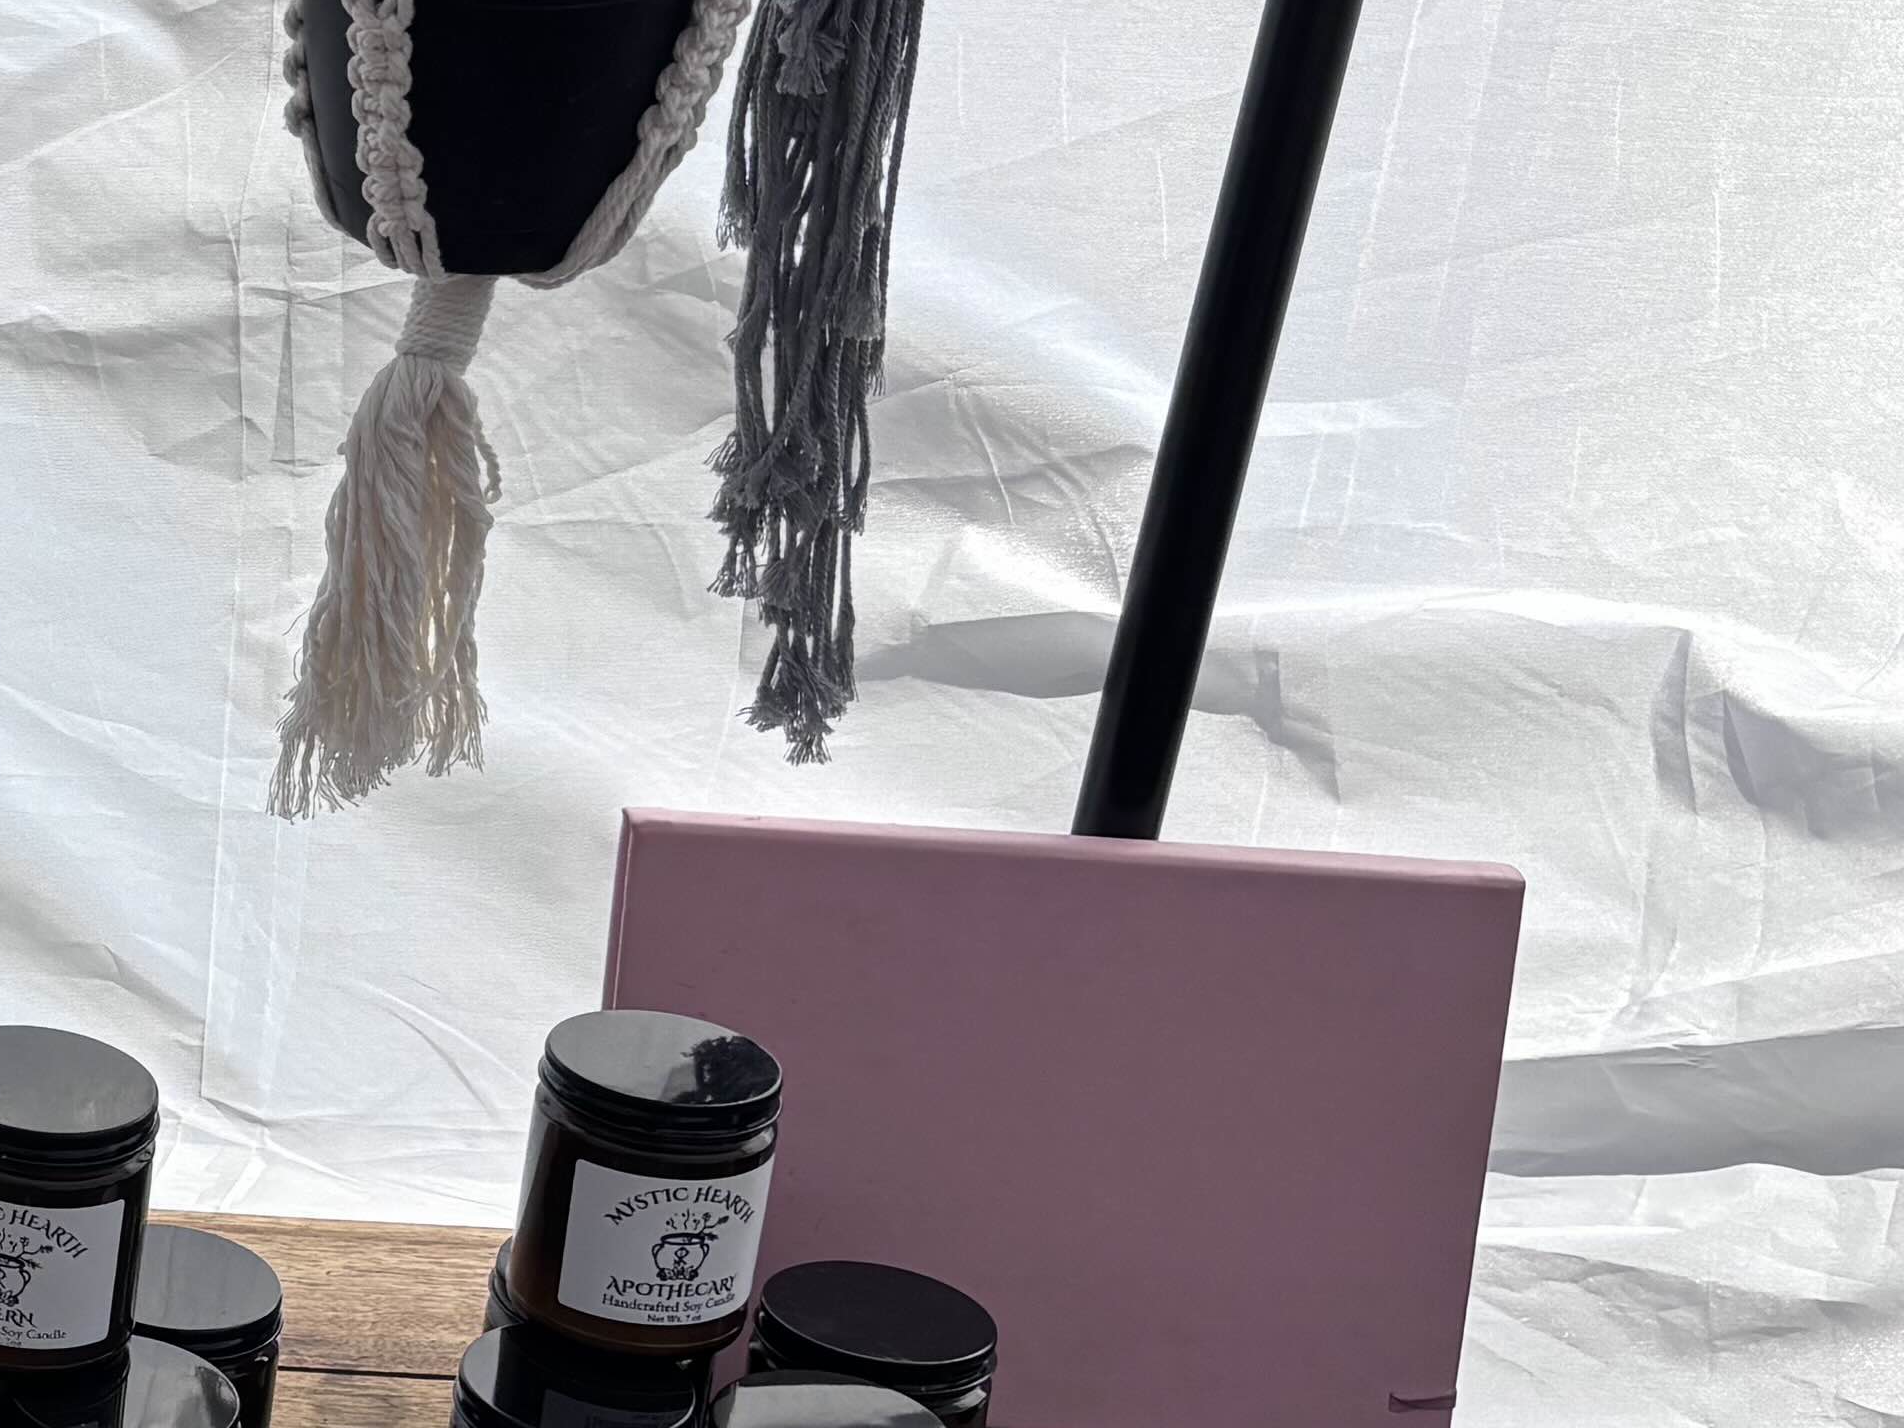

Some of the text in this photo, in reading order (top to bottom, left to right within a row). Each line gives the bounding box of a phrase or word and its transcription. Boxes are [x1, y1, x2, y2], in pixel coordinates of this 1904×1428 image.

[603, 1185, 755, 1225] MYSTIC HEARTH
[9, 1209, 88, 1259] HEARTH
[606, 1274, 737, 1301] APOTHECARY
